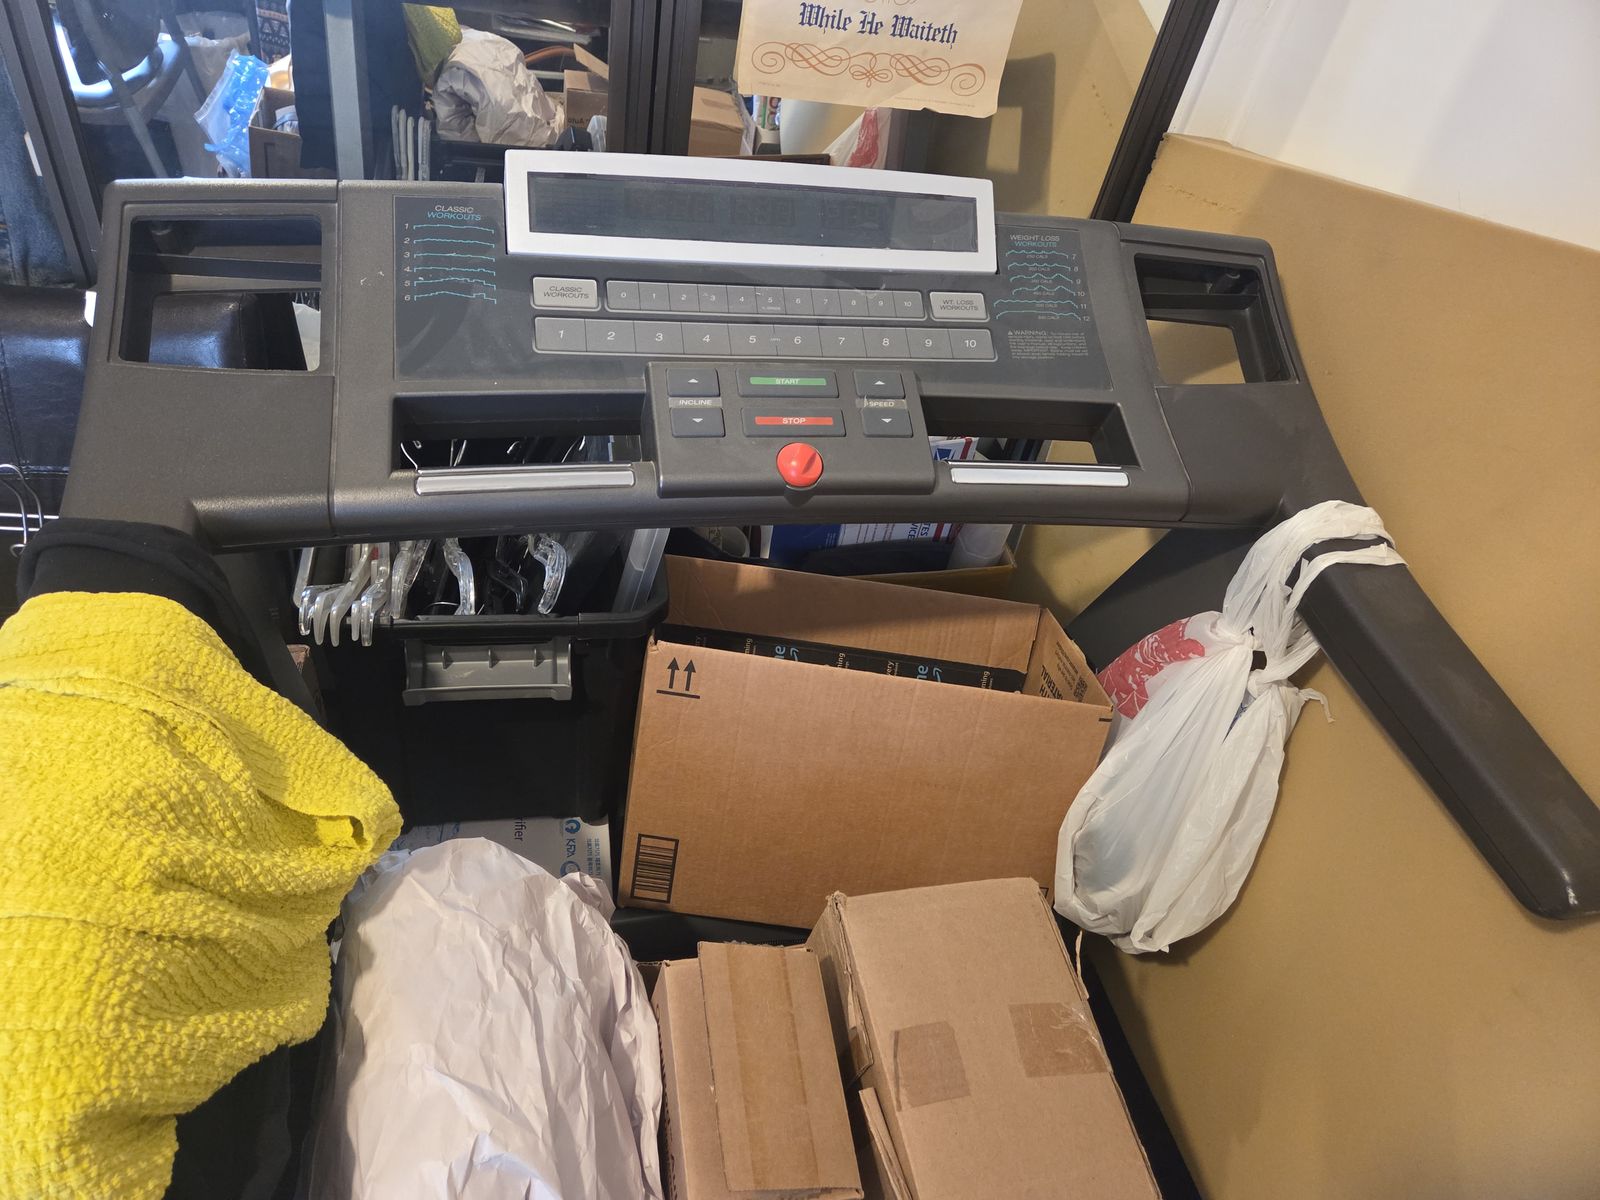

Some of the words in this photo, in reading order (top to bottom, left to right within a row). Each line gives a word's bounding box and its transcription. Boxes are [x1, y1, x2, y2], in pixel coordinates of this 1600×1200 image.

[799, 2, 852, 34] While
[857, 10, 884, 37] He
[890, 14, 958, 49] Waiteth
[434, 204, 474, 213] CLASSIC
[427, 212, 481, 220] WORKOUTS
[559, 330, 564, 339] 1
[607, 331, 616, 341] 2
[655, 333, 664, 342] 3
[702, 334, 711, 343] 4
[749, 335, 757, 344] 5
[838, 337, 845, 345] 7
[882, 338, 889, 346] 8
[925, 339, 932, 347] 9
[964, 340, 976, 348] 10
